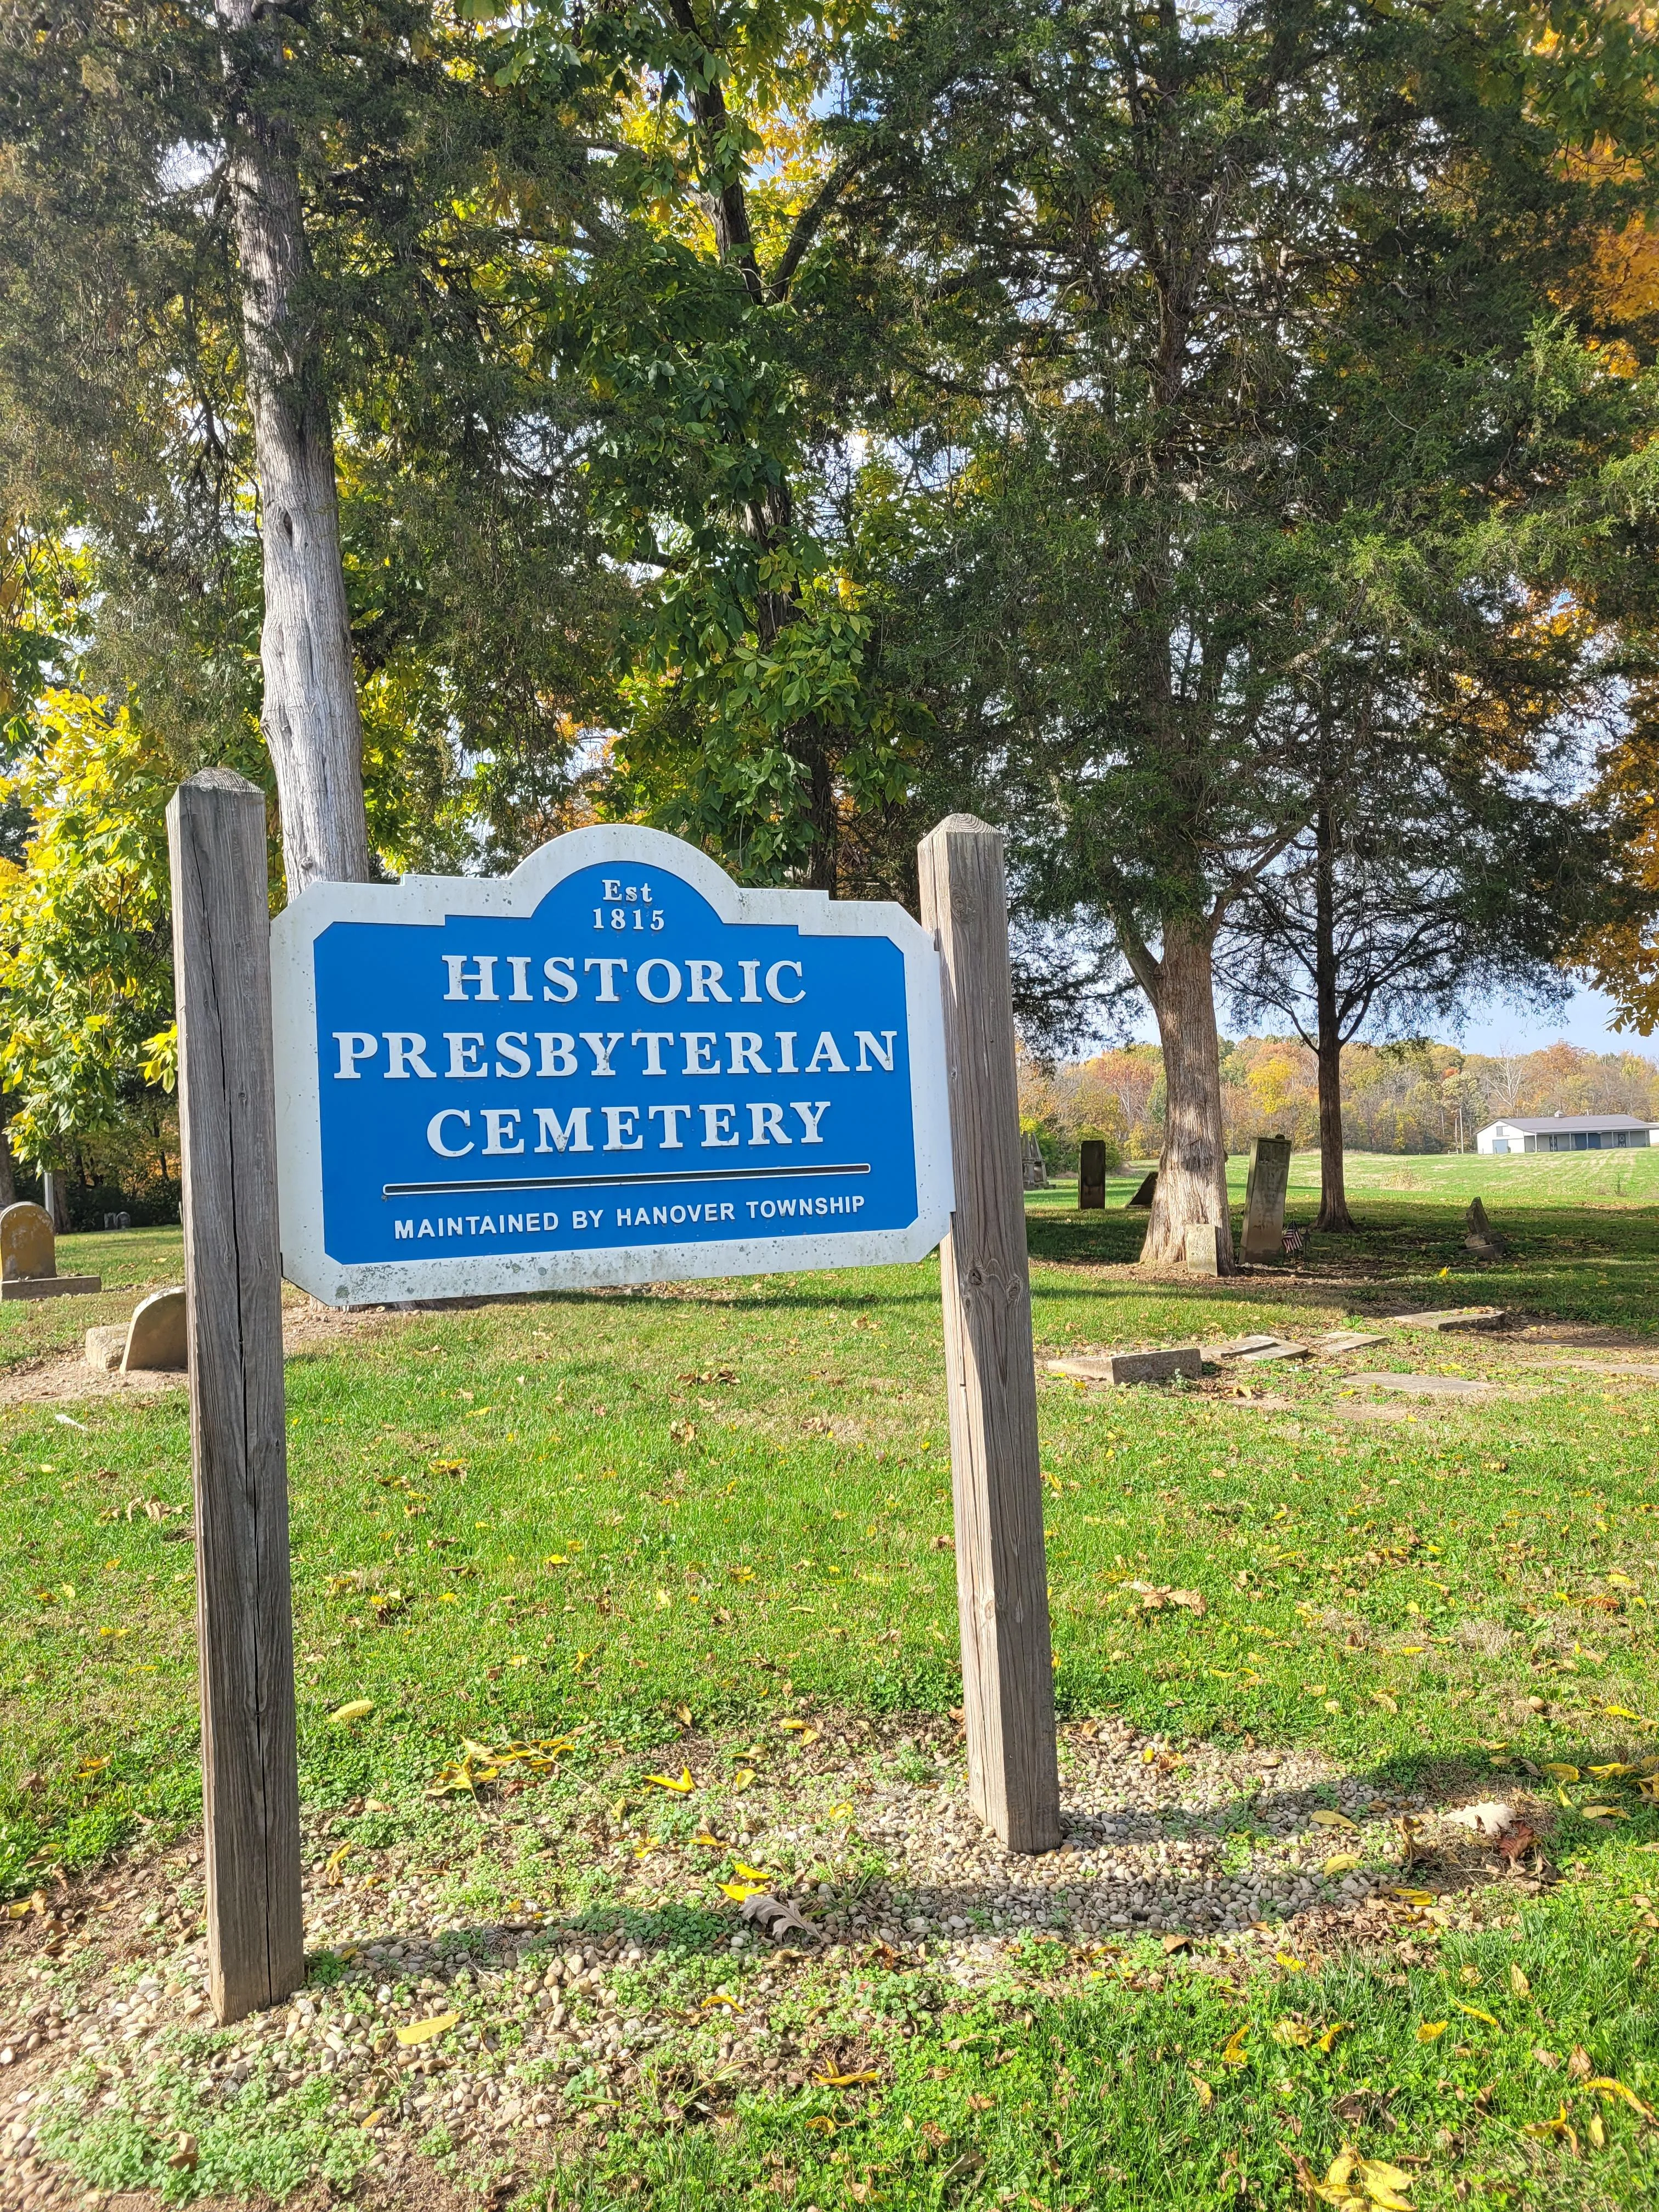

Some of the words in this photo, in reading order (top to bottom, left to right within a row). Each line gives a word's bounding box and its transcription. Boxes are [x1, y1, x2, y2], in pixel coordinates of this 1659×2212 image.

[602, 879, 653, 902] Est
[593, 907, 664, 930] 1815
[442, 955, 806, 1003] HISTORIC
[332, 1031, 898, 1079] PRESBYTERIAN
[427, 1101, 831, 1157] CEMETERY
[394, 1212, 558, 1239] MAINTAINED
[572, 1209, 603, 1229] BY
[617, 1203, 735, 1228] HANOVER
[746, 1195, 865, 1218] TOWNSHIP
